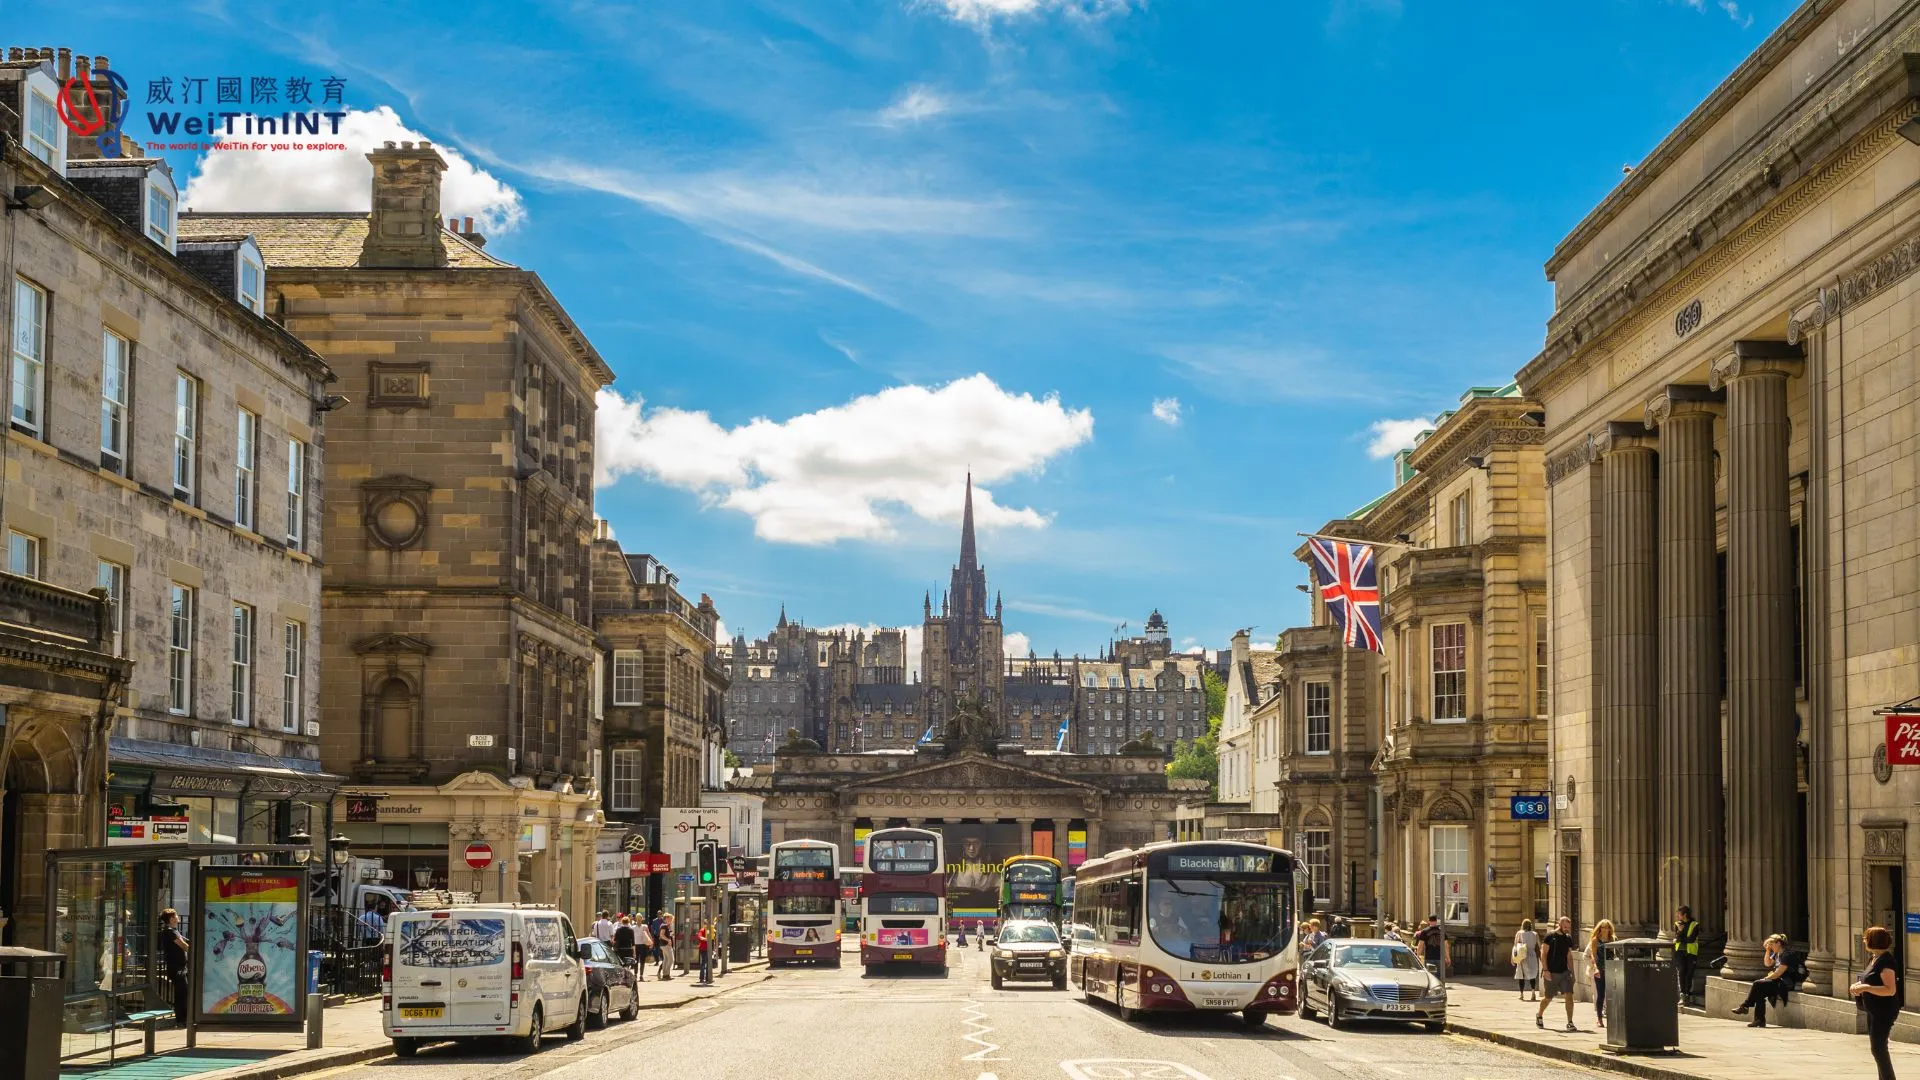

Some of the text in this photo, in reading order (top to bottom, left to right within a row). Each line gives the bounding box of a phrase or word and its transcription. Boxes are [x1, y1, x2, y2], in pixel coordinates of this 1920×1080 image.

[1517, 803, 1544, 812] TSB
[1247, 858, 1265, 871] 42
[1213, 972, 1242, 980] Lothian
